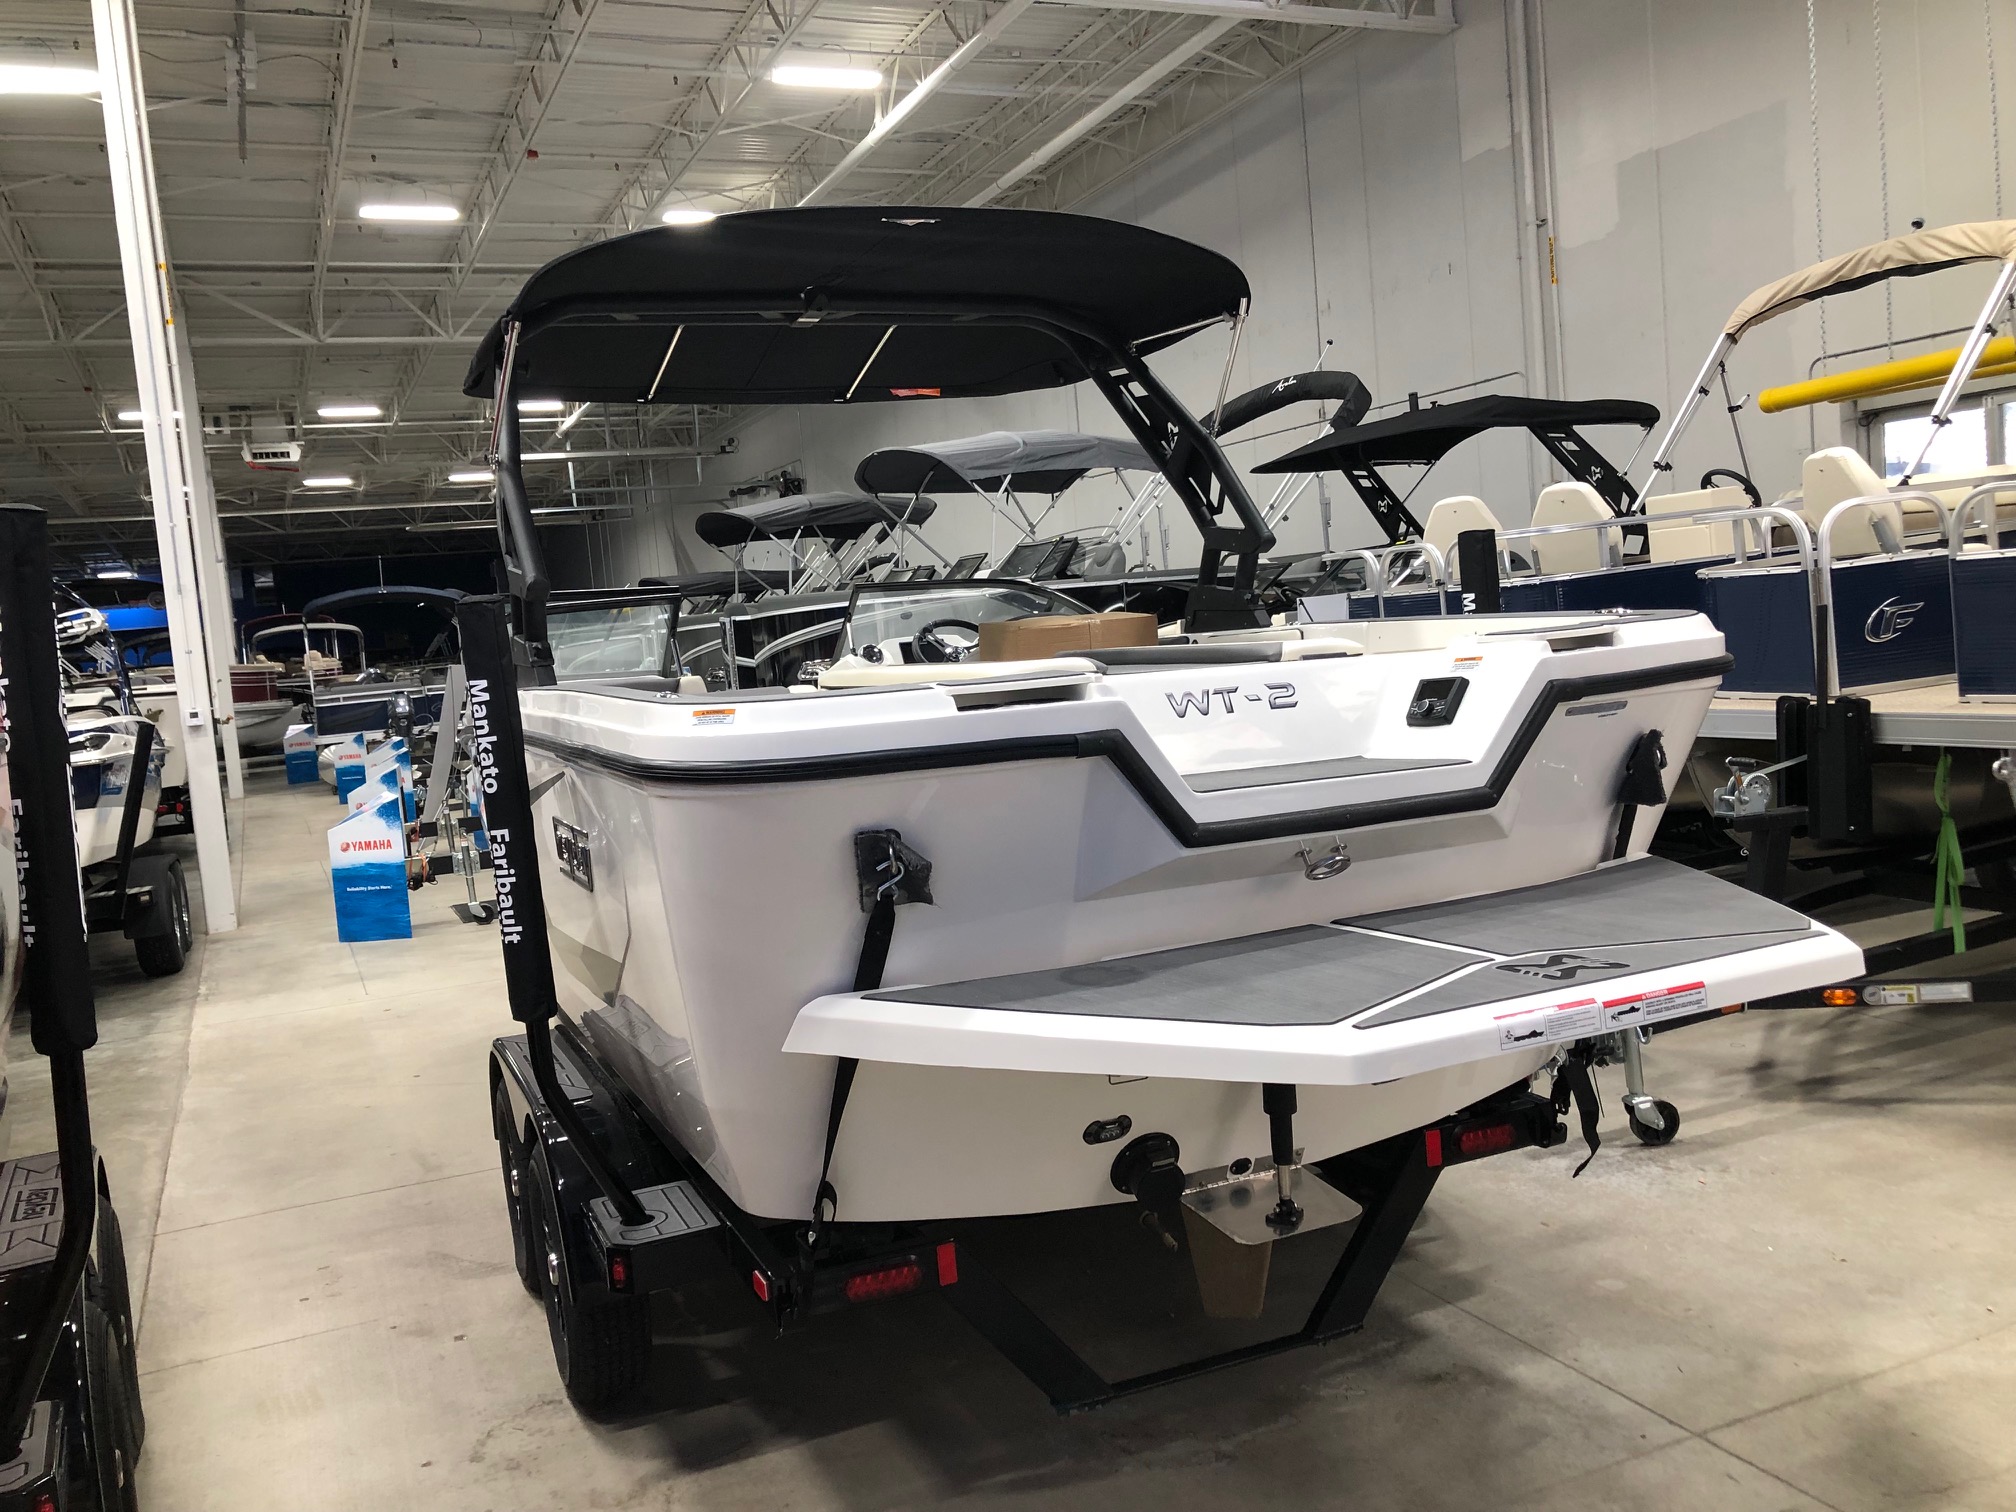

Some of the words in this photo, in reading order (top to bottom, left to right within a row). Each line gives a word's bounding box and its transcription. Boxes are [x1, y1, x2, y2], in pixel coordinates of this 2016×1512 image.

[469, 679, 501, 794] Mankato
[1164, 681, 1299, 719] WT-2
[351, 839, 392, 851] YAMAHA
[489, 828, 523, 944] Faribault
